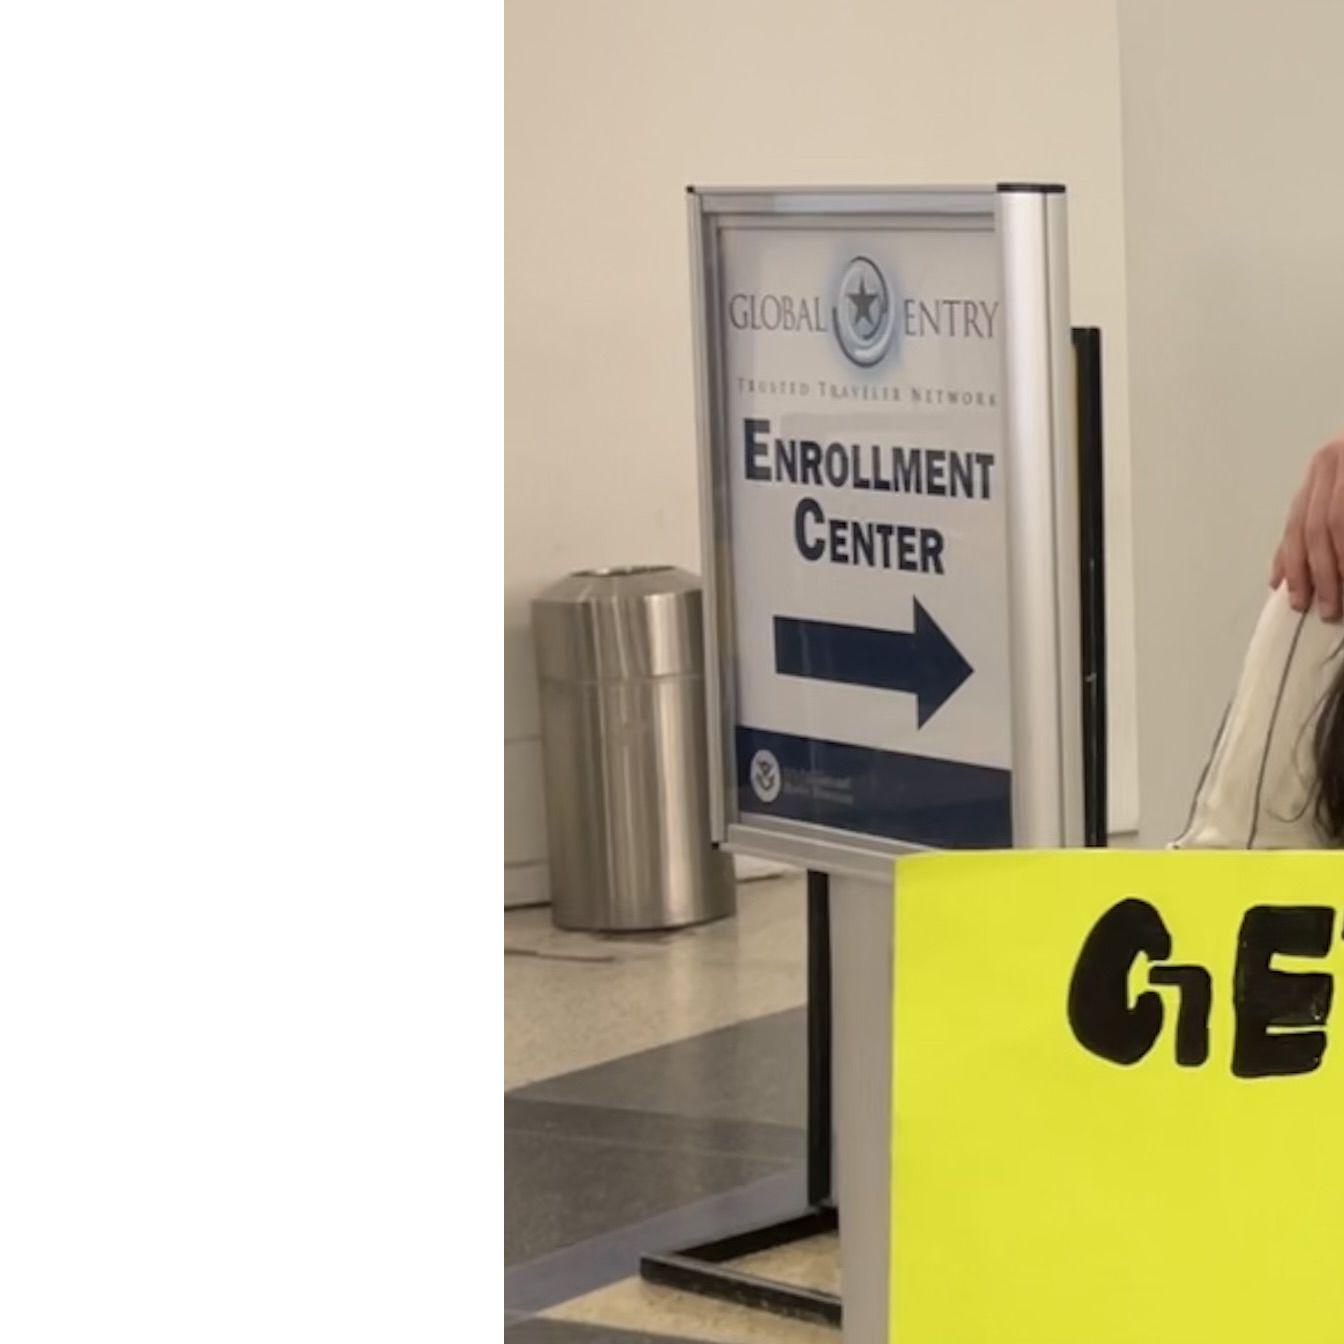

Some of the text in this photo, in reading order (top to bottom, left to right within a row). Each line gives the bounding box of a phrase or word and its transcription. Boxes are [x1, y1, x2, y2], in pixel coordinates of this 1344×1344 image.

[729, 294, 999, 338] GLOBAL ENTRY
[910, 388, 998, 407] NETWORK
[744, 418, 995, 499] ENROLLMENT
[794, 497, 945, 575] CENTER
